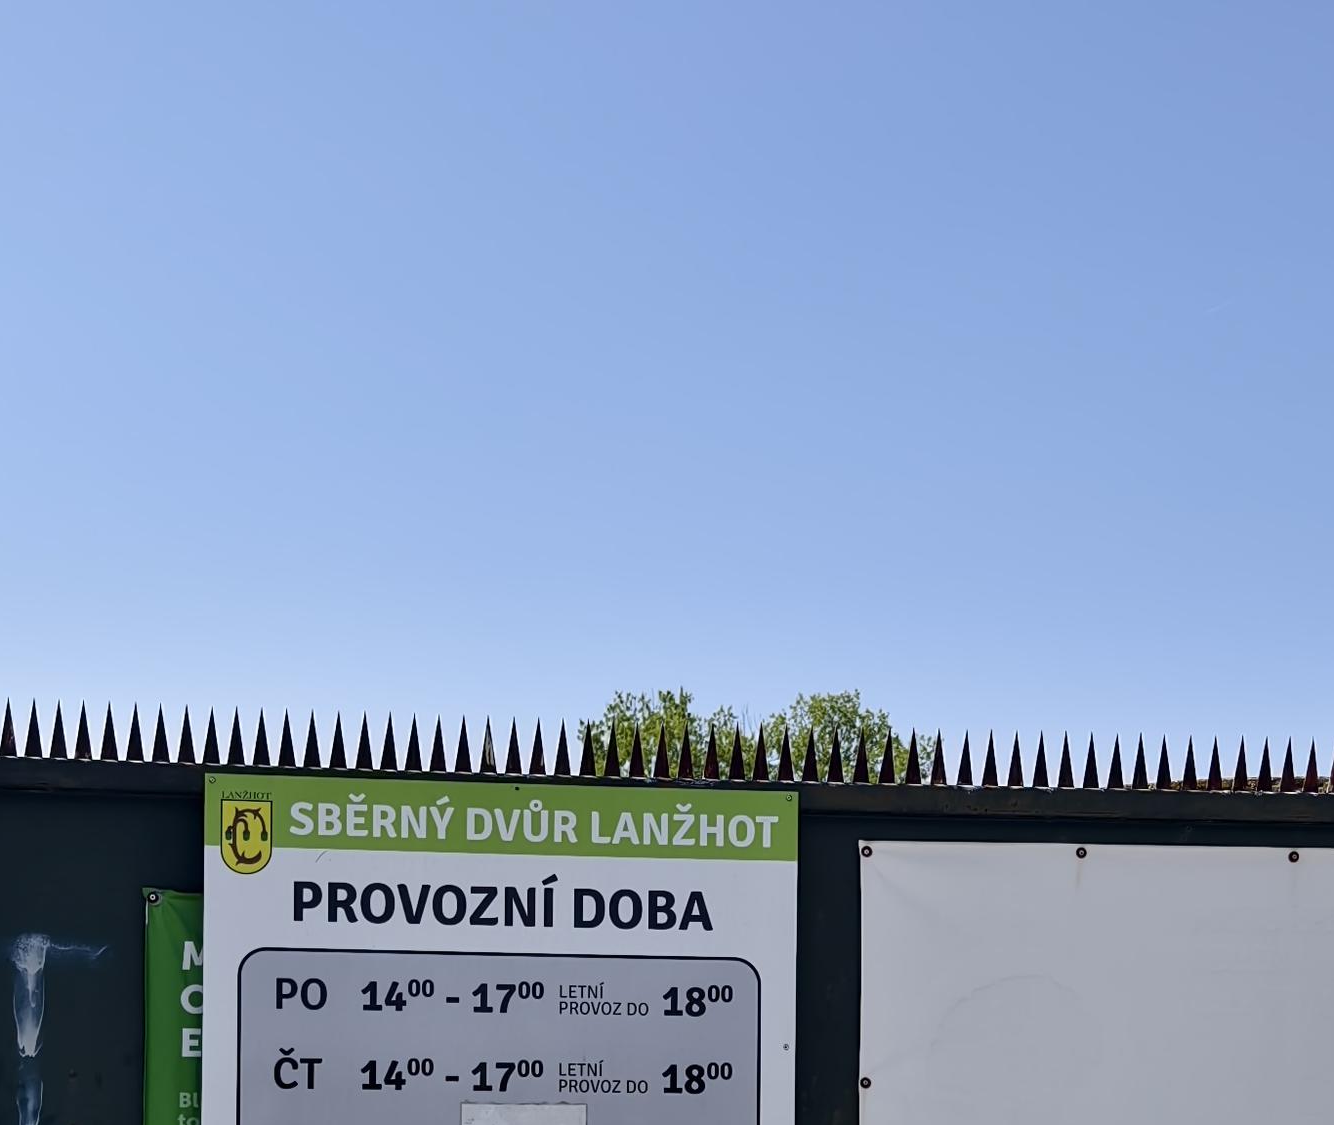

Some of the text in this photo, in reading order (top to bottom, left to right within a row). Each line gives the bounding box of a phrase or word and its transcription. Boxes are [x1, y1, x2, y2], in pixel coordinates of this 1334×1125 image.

[221, 790, 273, 801] LANŽHOT
[289, 793, 779, 849] SBĚRNÝ DVŮR LANŽHOT
[293, 873, 714, 931] PROVOZNÍ DOBA
[275, 977, 328, 1011] PO
[559, 982, 605, 999] LETNÍ
[558, 1001, 650, 1016] PROVOZ DO
[273, 1048, 323, 1090] ČT
[558, 1060, 604, 1077] LETNÍ
[558, 1079, 649, 1094] PROVOZ DO
